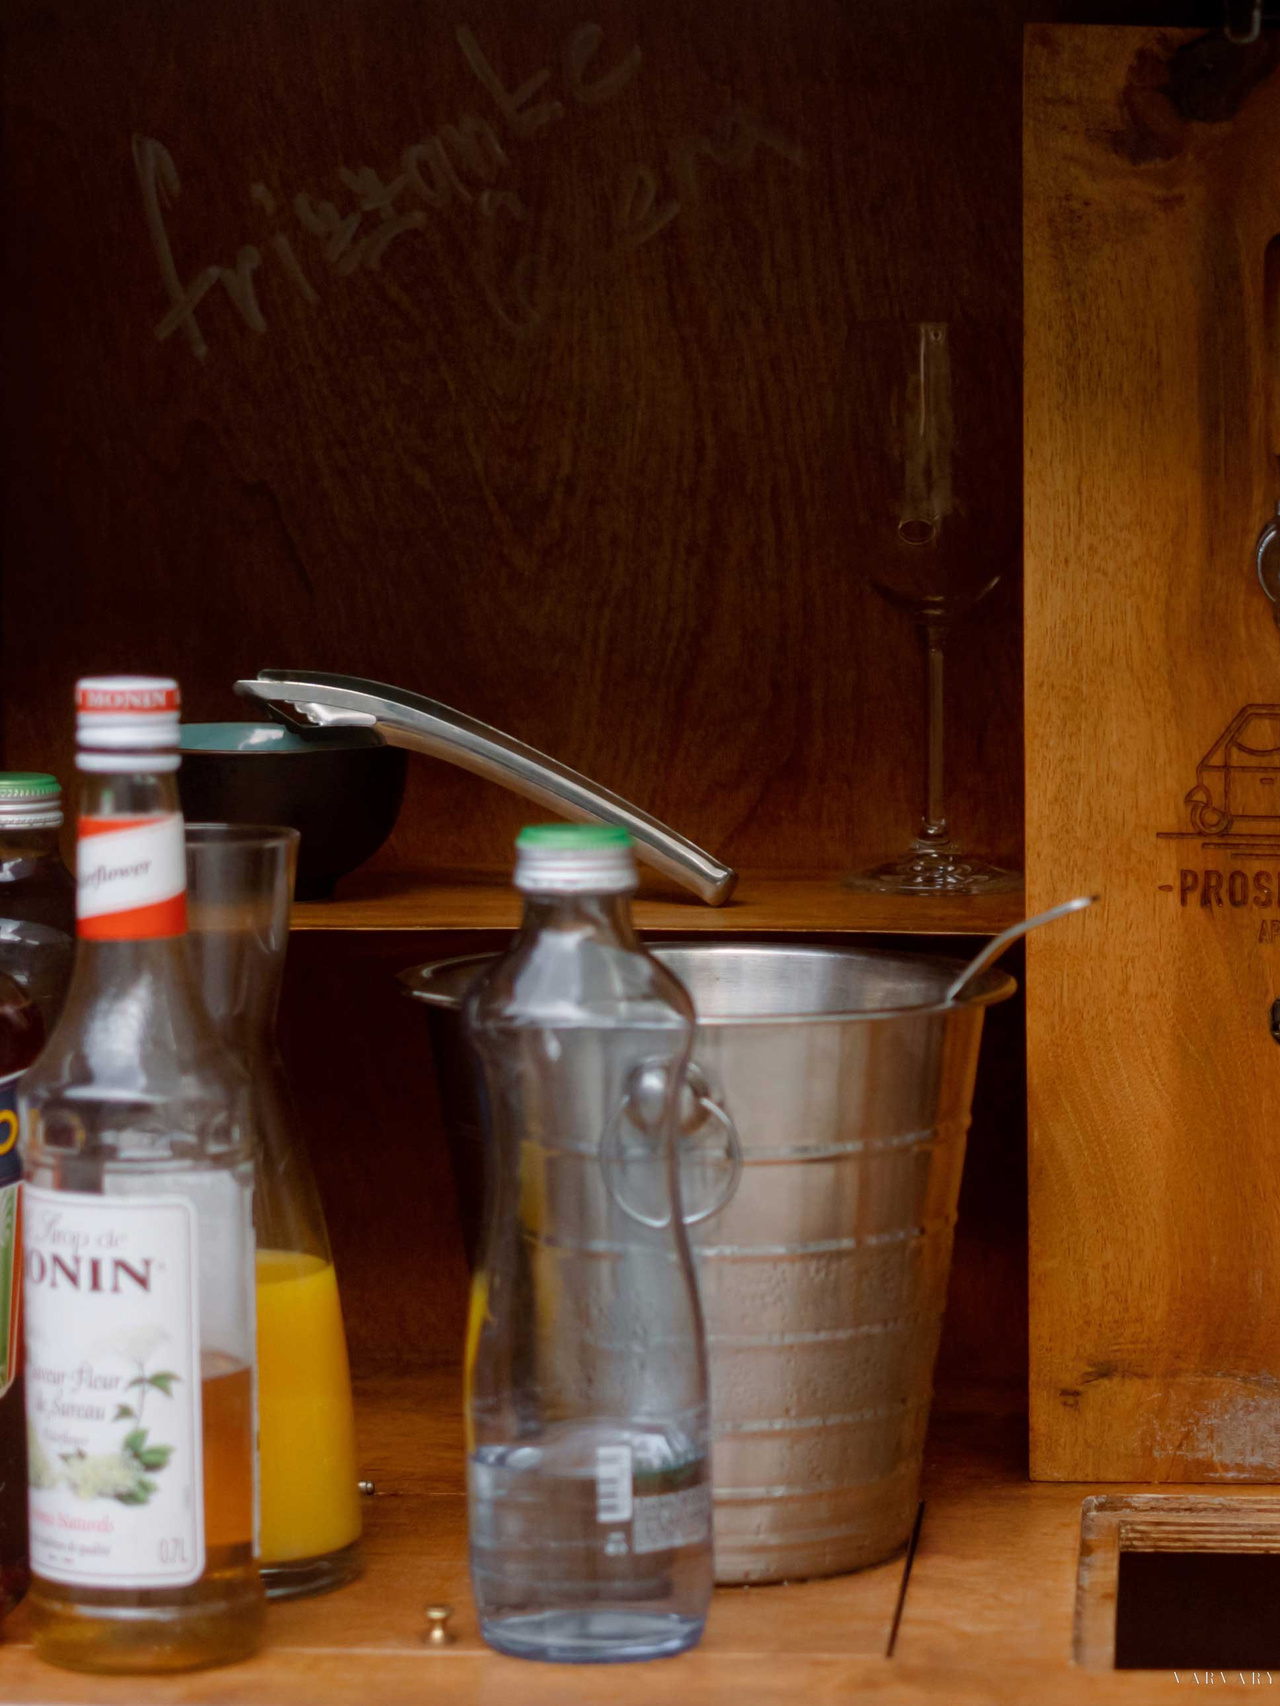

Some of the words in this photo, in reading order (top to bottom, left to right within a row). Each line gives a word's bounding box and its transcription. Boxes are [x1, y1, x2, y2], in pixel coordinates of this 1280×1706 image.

[88, 690, 166, 708] MONIN
[77, 860, 152, 890] erflower
[26, 1248, 155, 1294] ONIN
